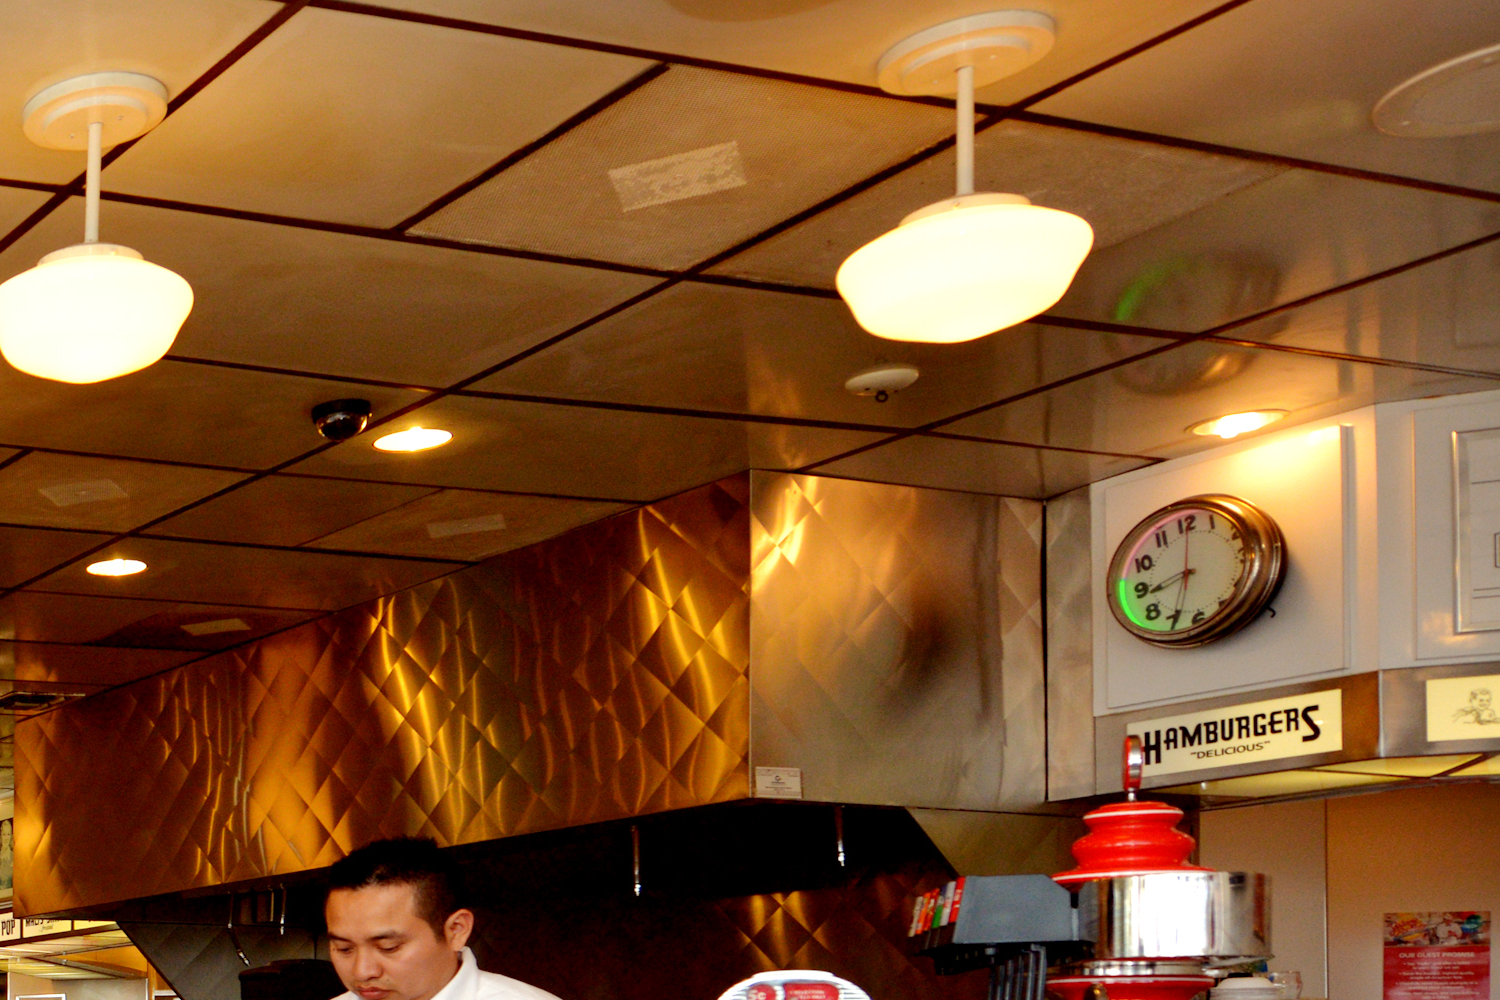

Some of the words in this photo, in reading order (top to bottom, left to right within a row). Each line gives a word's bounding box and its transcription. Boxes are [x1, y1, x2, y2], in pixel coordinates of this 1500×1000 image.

[1178, 514, 1196, 534] 12
[1209, 514, 1215, 530] 1
[1155, 530, 1169, 548] 11
[1135, 554, 1153, 573] 10
[1134, 582, 1149, 599] 9
[1145, 603, 1161, 621] 8
[1166, 610, 1182, 631] 7
[1143, 705, 1321, 766] HAMBURGERS
[1190, 740, 1271, 760] "DELICIOUS"
[1, 919, 16, 936] POP
